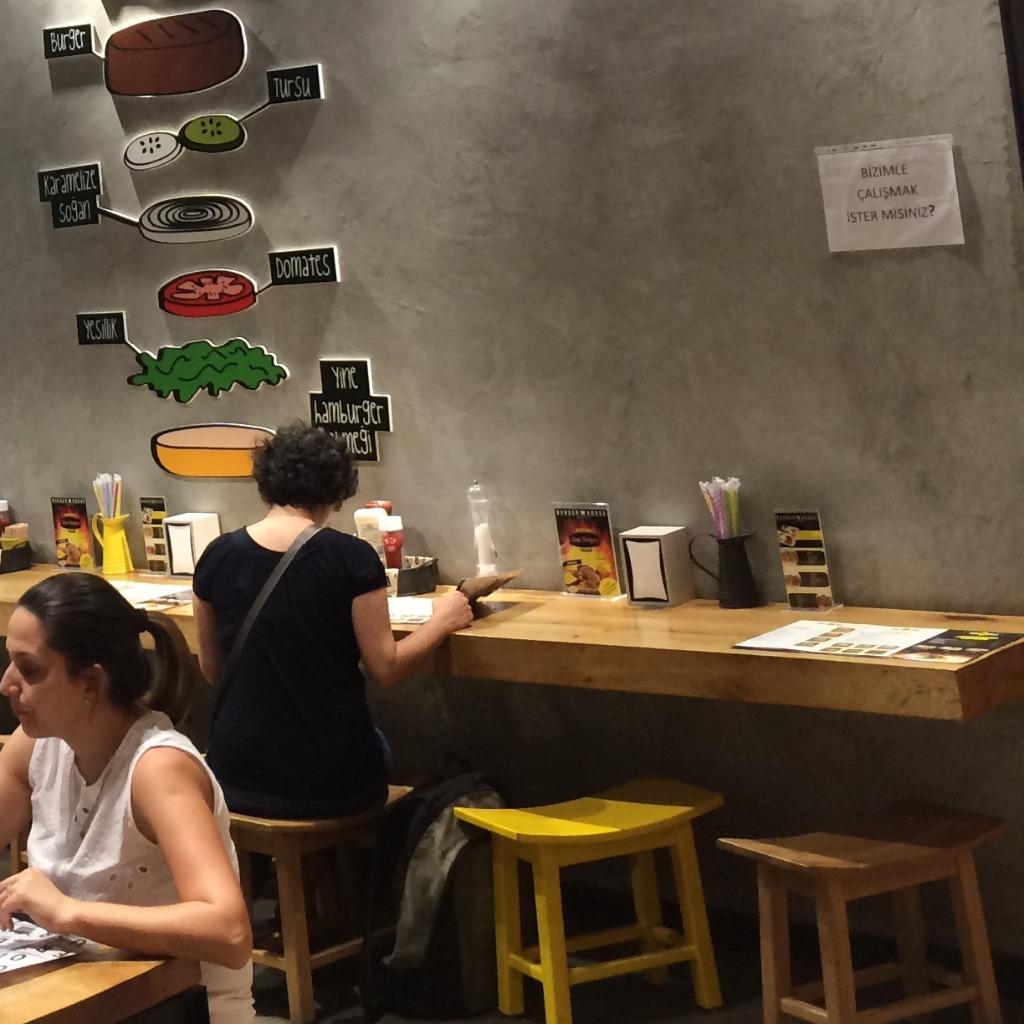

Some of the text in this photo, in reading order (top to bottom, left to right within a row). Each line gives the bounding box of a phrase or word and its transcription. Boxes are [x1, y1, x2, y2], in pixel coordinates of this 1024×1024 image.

[50, 28, 86, 53] Burger
[44, 169, 97, 197] Karamelize
[857, 184, 919, 202] ÇALIŞMAK
[276, 253, 331, 279] Domates
